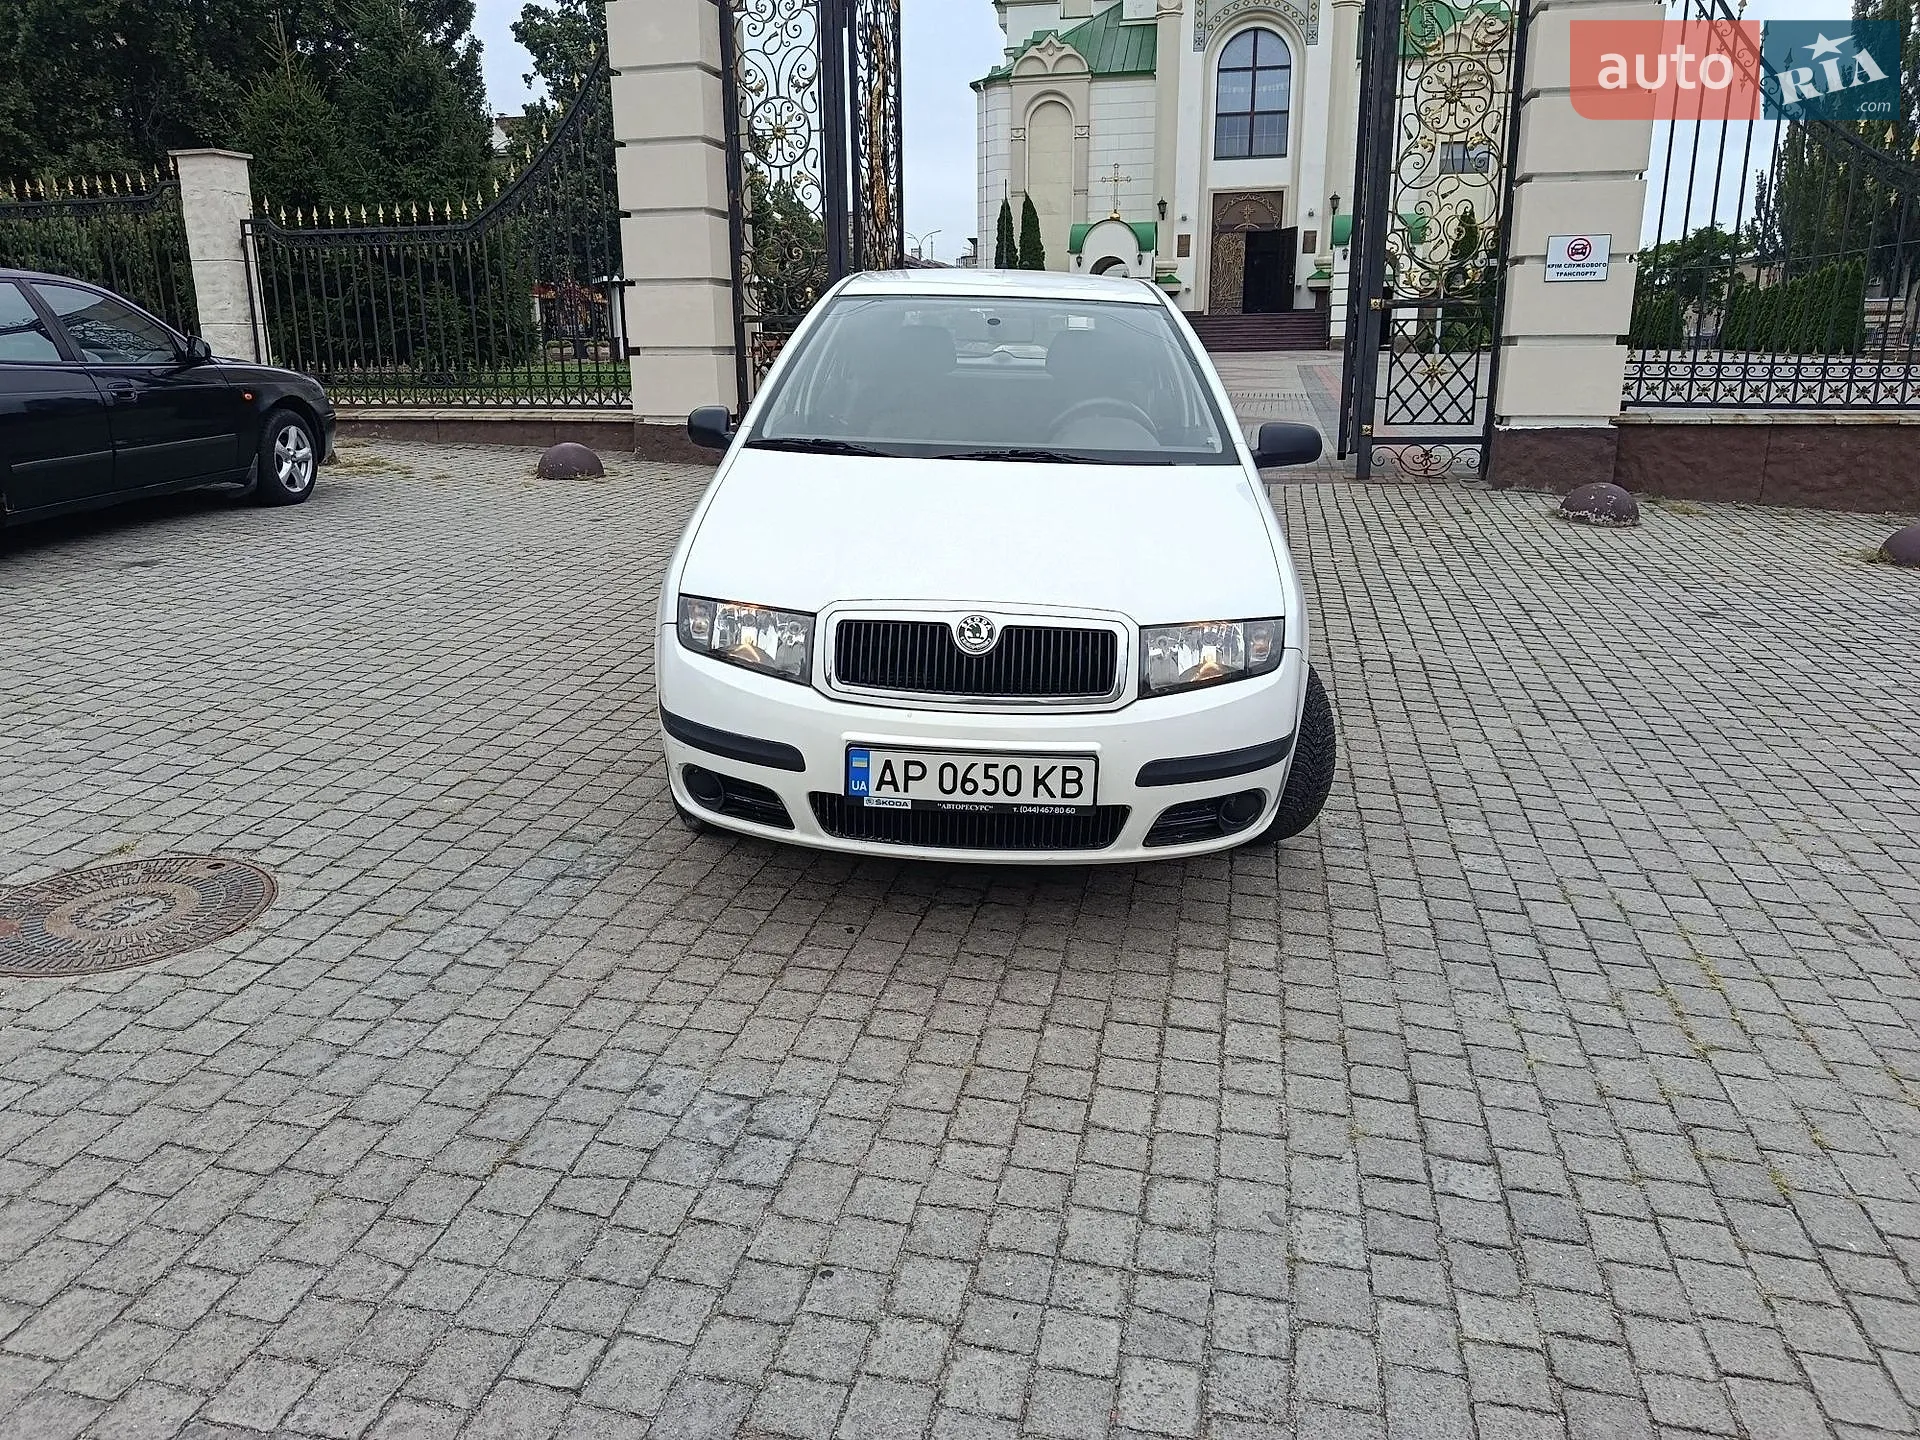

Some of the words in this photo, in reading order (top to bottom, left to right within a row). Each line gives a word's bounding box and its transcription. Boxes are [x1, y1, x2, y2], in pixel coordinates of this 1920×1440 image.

[851, 779, 868, 792] UA
[875, 759, 928, 793] AP
[938, 762, 1022, 797] 0650
[1032, 765, 1084, 799] KB
